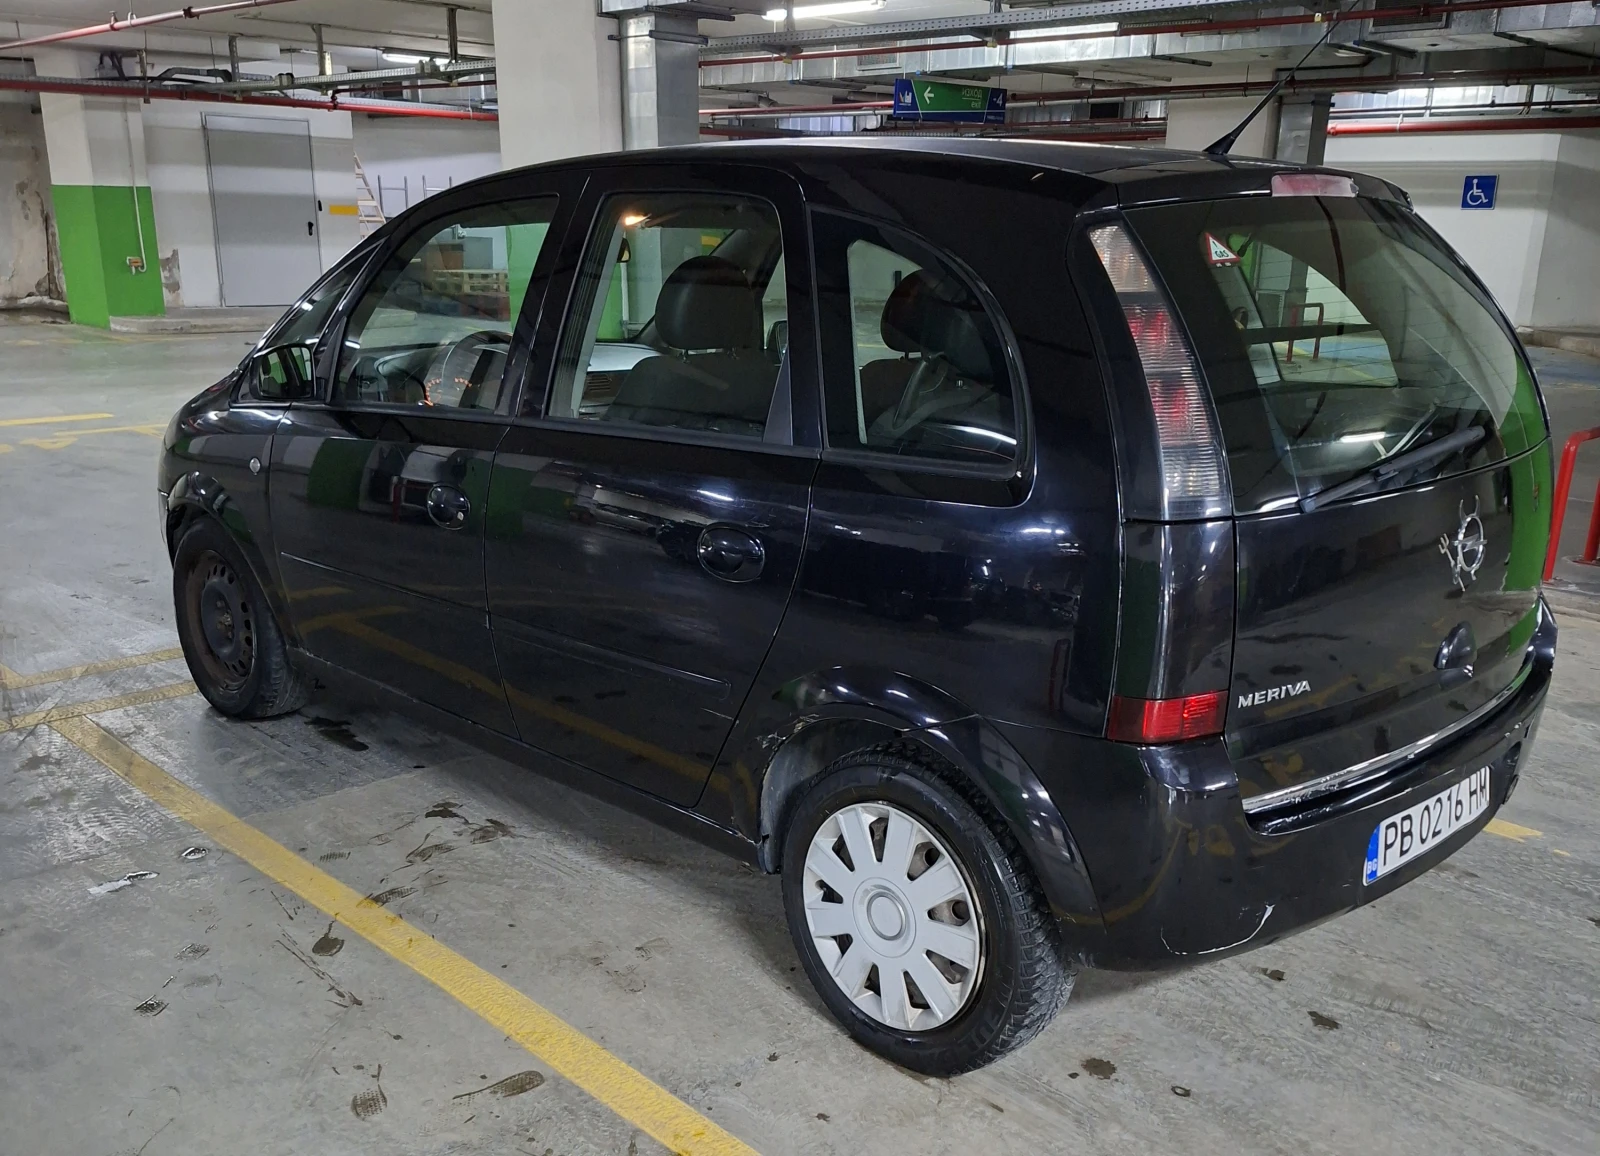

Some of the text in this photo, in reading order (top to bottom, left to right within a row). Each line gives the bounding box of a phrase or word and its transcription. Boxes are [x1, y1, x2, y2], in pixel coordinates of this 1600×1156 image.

[1215, 250, 1229, 258] GAS
[1237, 680, 1311, 709] MERIVA
[1383, 814, 1413, 867] PB
[1420, 783, 1464, 845] 0216
[1367, 858, 1378, 874] BG
